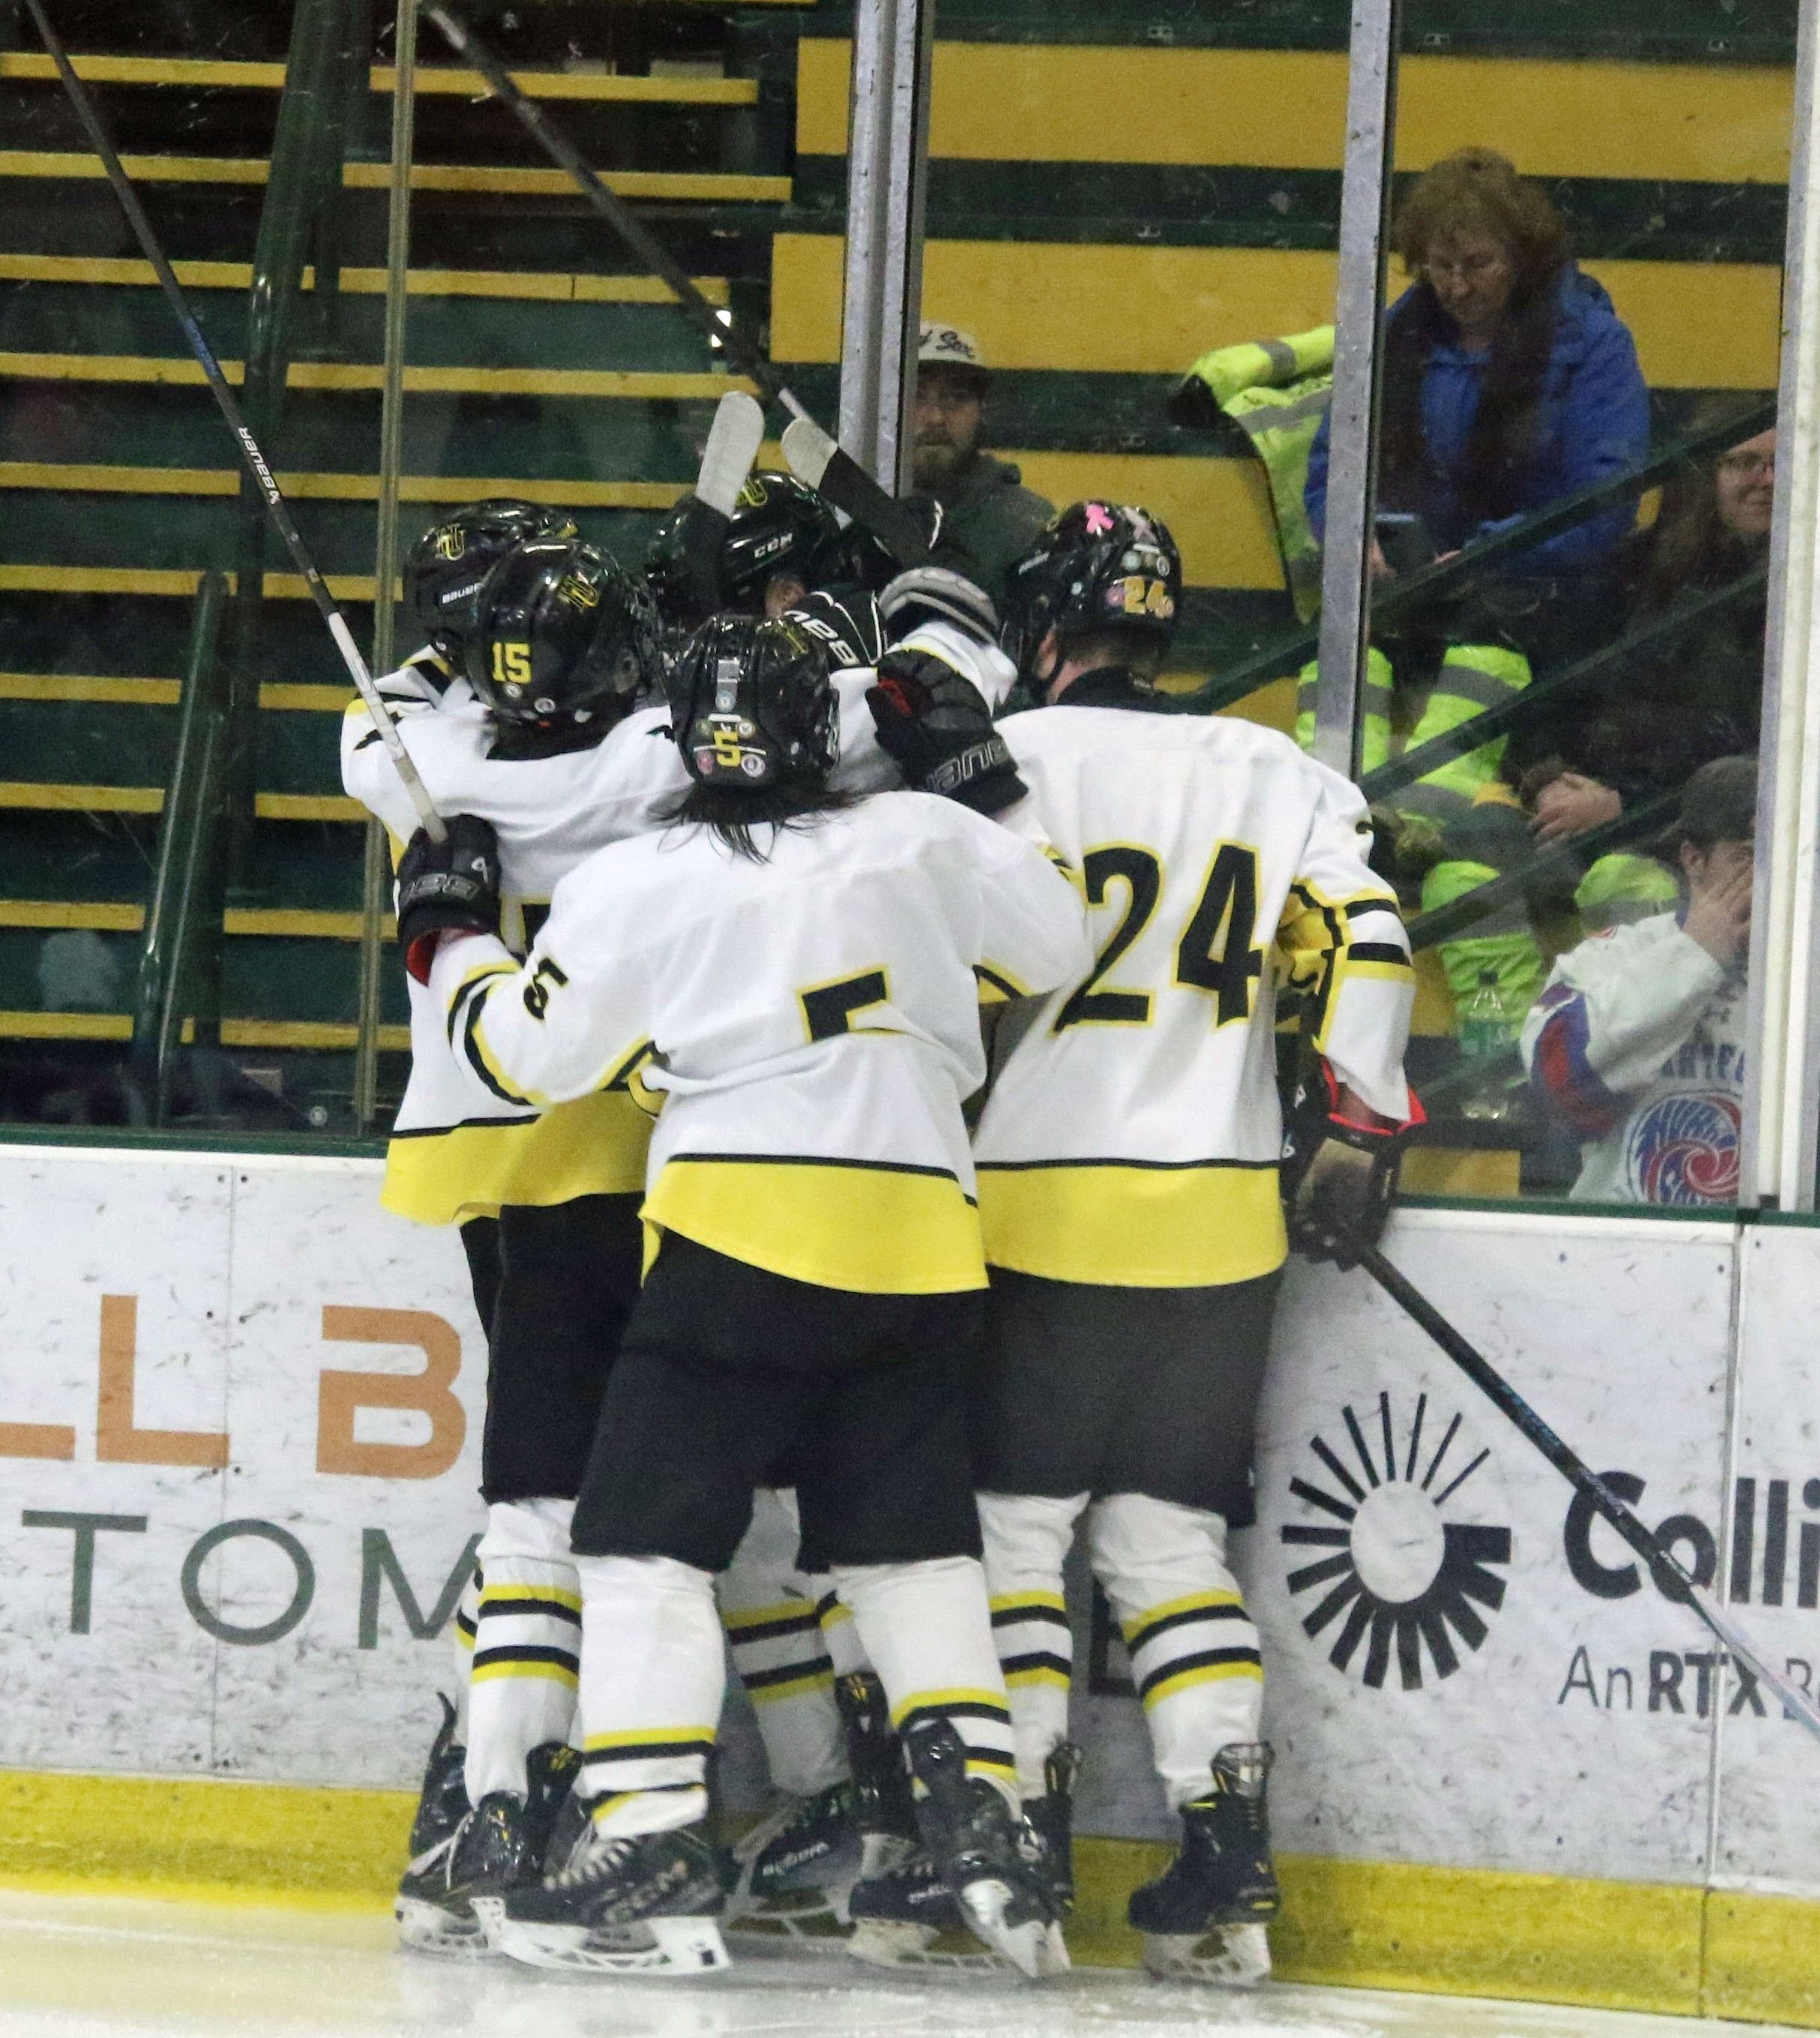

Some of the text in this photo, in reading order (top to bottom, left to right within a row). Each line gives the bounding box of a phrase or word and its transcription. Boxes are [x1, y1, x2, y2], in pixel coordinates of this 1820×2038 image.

[238, 427, 276, 489] BAUER
[753, 532, 792, 559] CCM
[1124, 576, 1174, 619] 24
[492, 641, 533, 684] 15
[714, 730, 741, 768] 5
[1052, 837, 1266, 1034] 24
[1558, 1646, 1634, 1711] An
[1648, 1651, 1768, 1720] RTX
